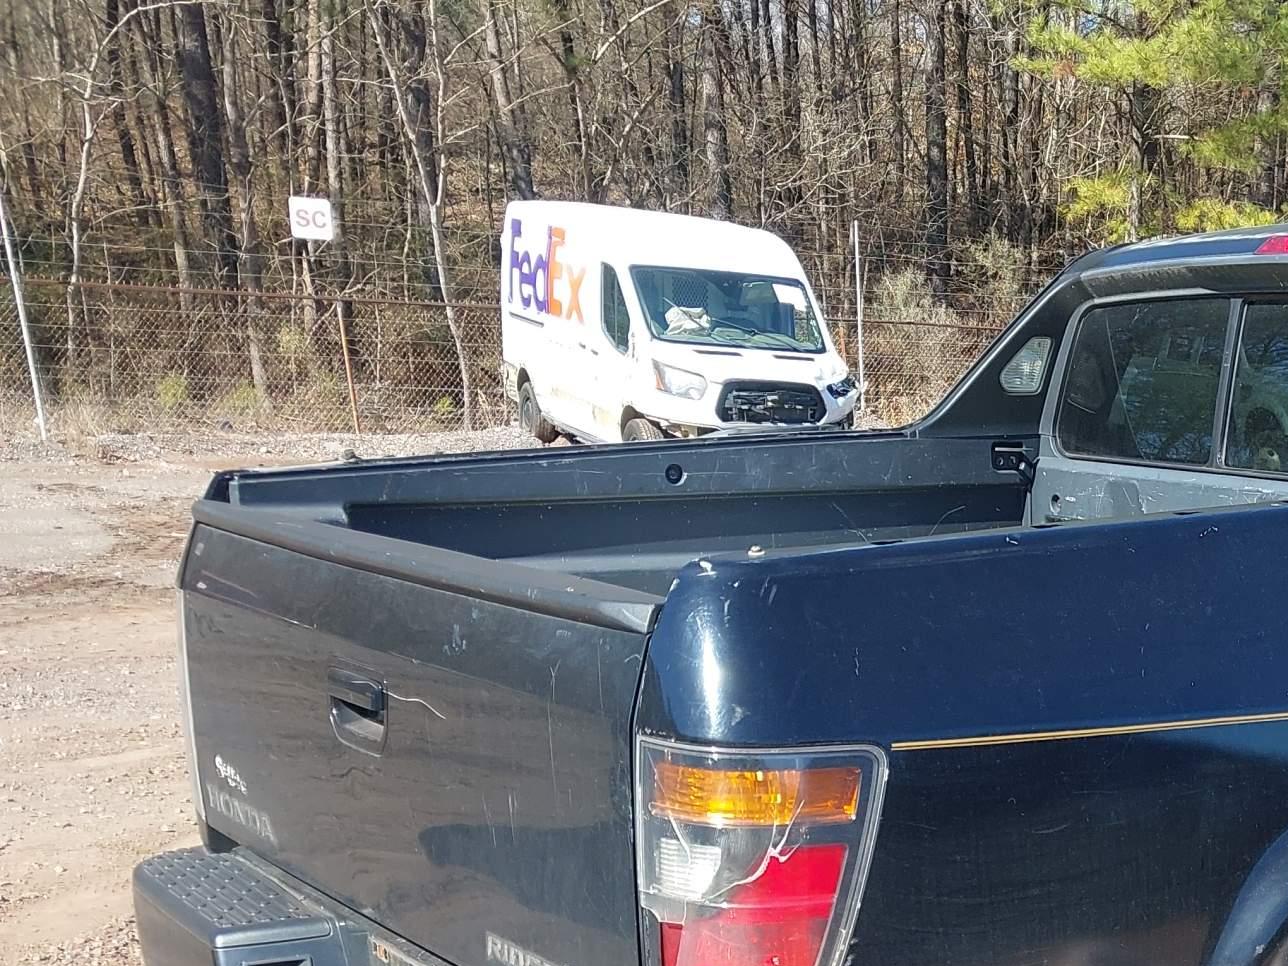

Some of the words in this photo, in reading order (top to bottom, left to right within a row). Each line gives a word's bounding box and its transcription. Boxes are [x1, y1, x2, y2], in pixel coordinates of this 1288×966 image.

[295, 209, 327, 229] SC
[508, 218, 587, 325] FedEx
[206, 784, 277, 846] HONDA
